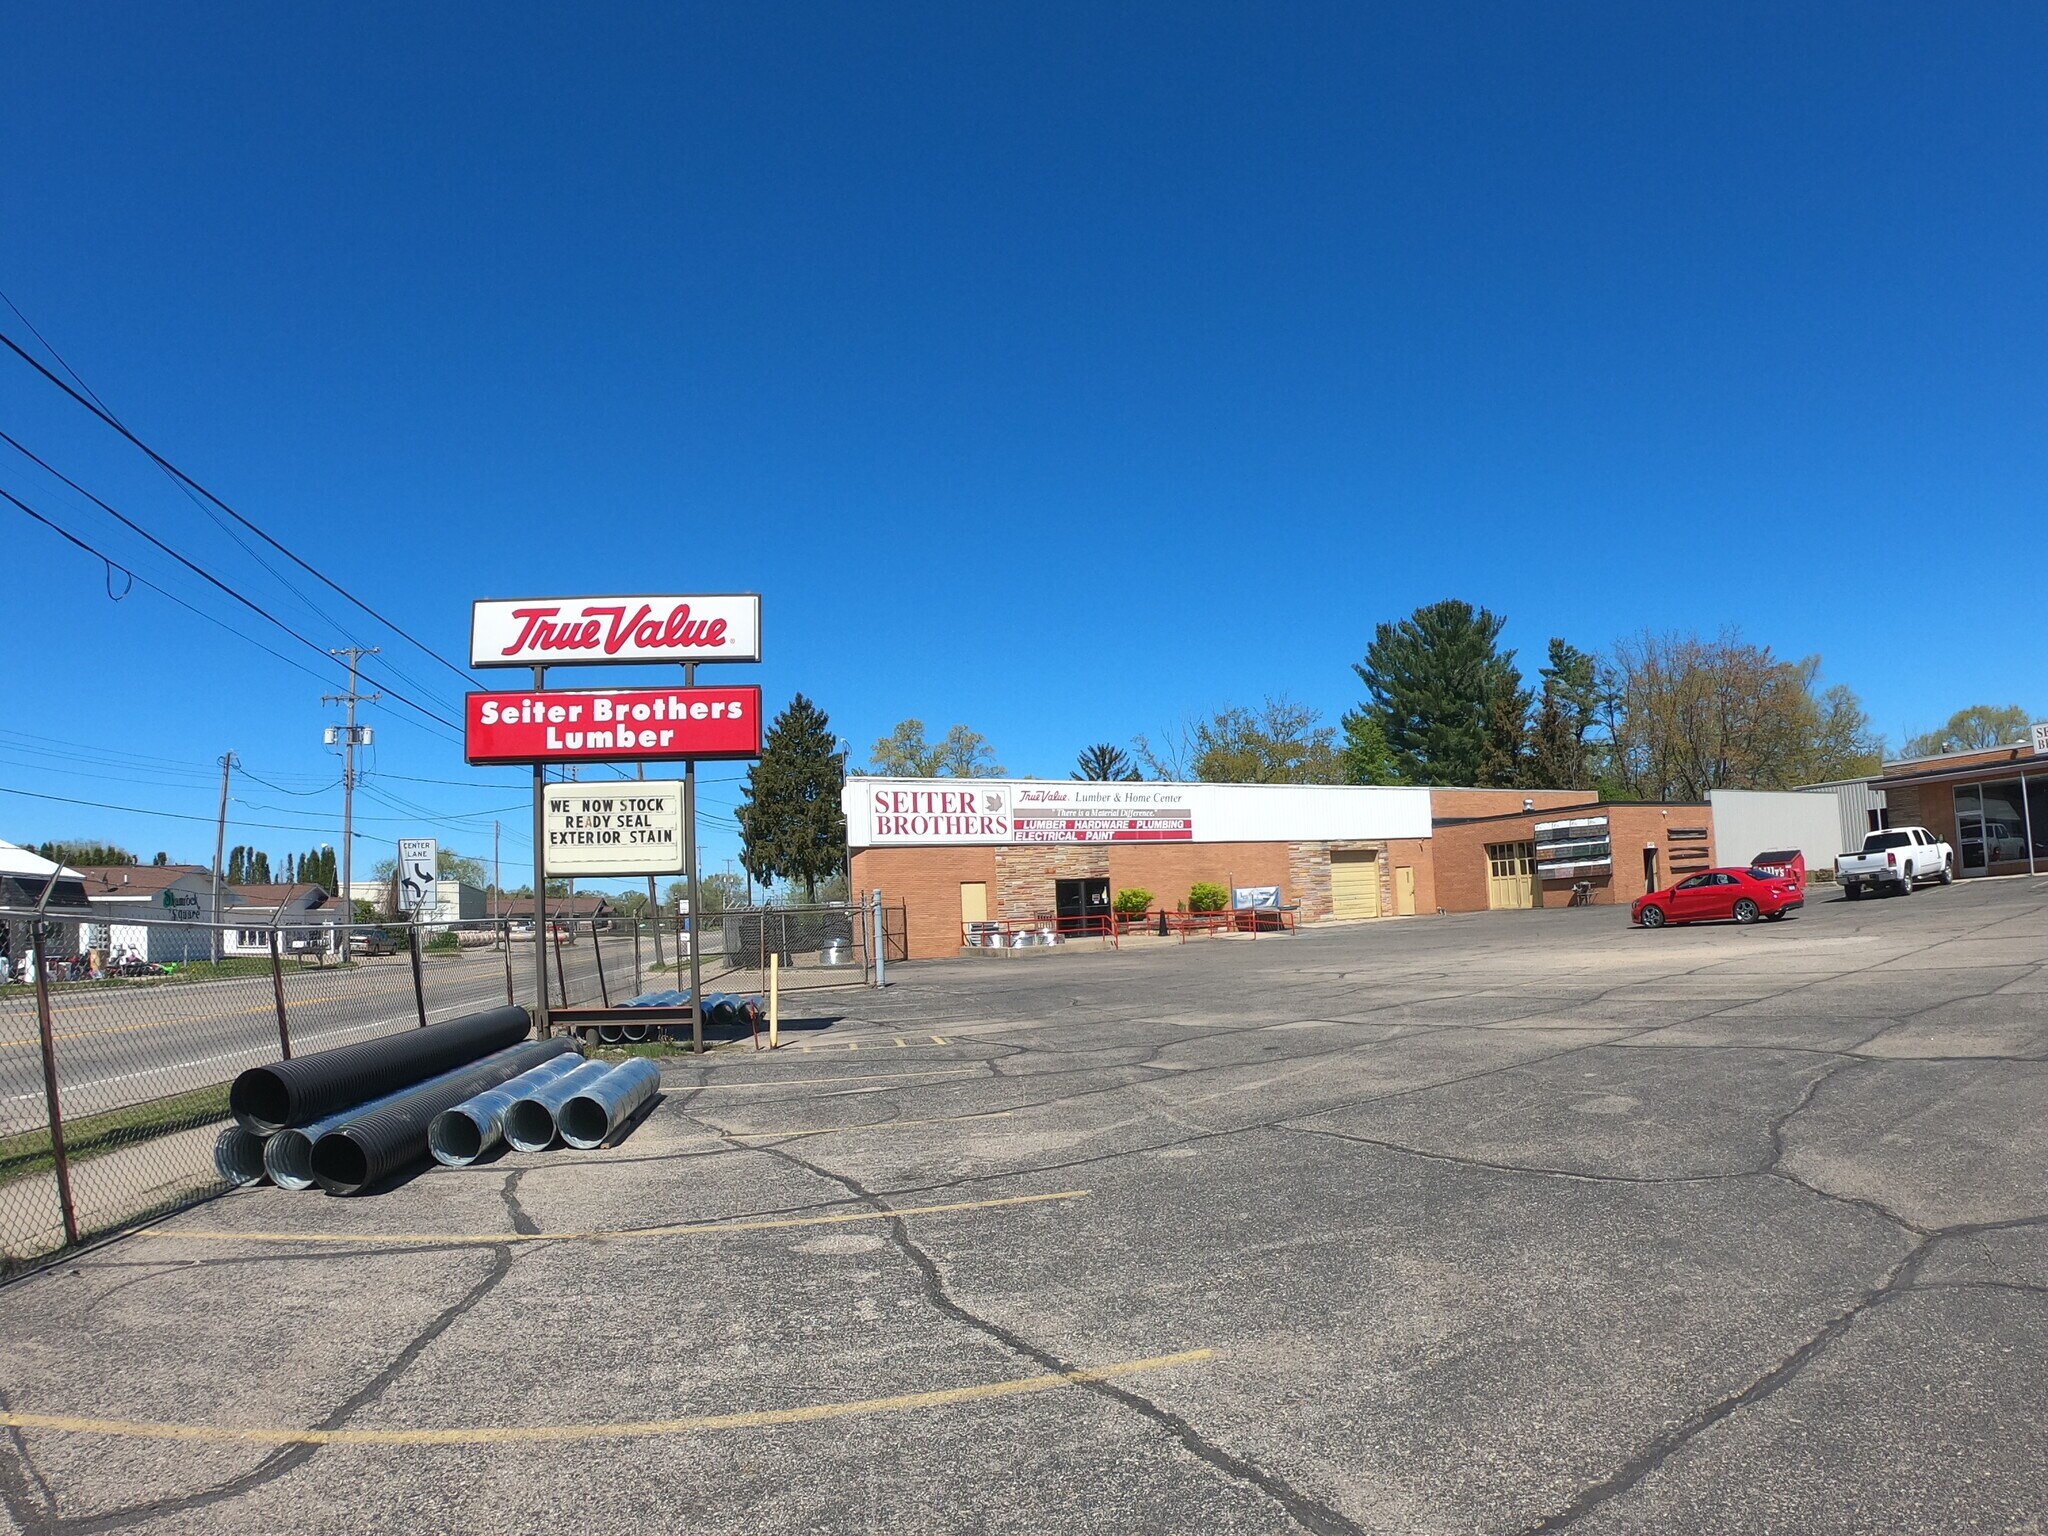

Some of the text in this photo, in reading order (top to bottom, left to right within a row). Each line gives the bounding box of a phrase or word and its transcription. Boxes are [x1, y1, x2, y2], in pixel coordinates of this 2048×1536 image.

[480, 696, 743, 725] Seiter Brothers
[546, 724, 674, 750] Lumber
[875, 790, 977, 814] SEITER
[1075, 792, 1110, 803] Lumber
[1113, 793, 1122, 803] &
[1125, 793, 1150, 803] Home
[1153, 793, 1183, 803] Center
[550, 798, 664, 813] WE NOW STOCK
[1077, 809, 1084, 817] is
[1091, 809, 1120, 817] Material
[565, 814, 652, 828] READY SEAL
[876, 815, 1008, 835] BROTHERS
[1023, 819, 1184, 829] LUMBER HARDWARE PLUMBING
[550, 829, 672, 844] EXTERIOR STAIN
[1015, 831, 1115, 841] ELECTRICAL PAINT
[403, 842, 430, 850] CENTER
